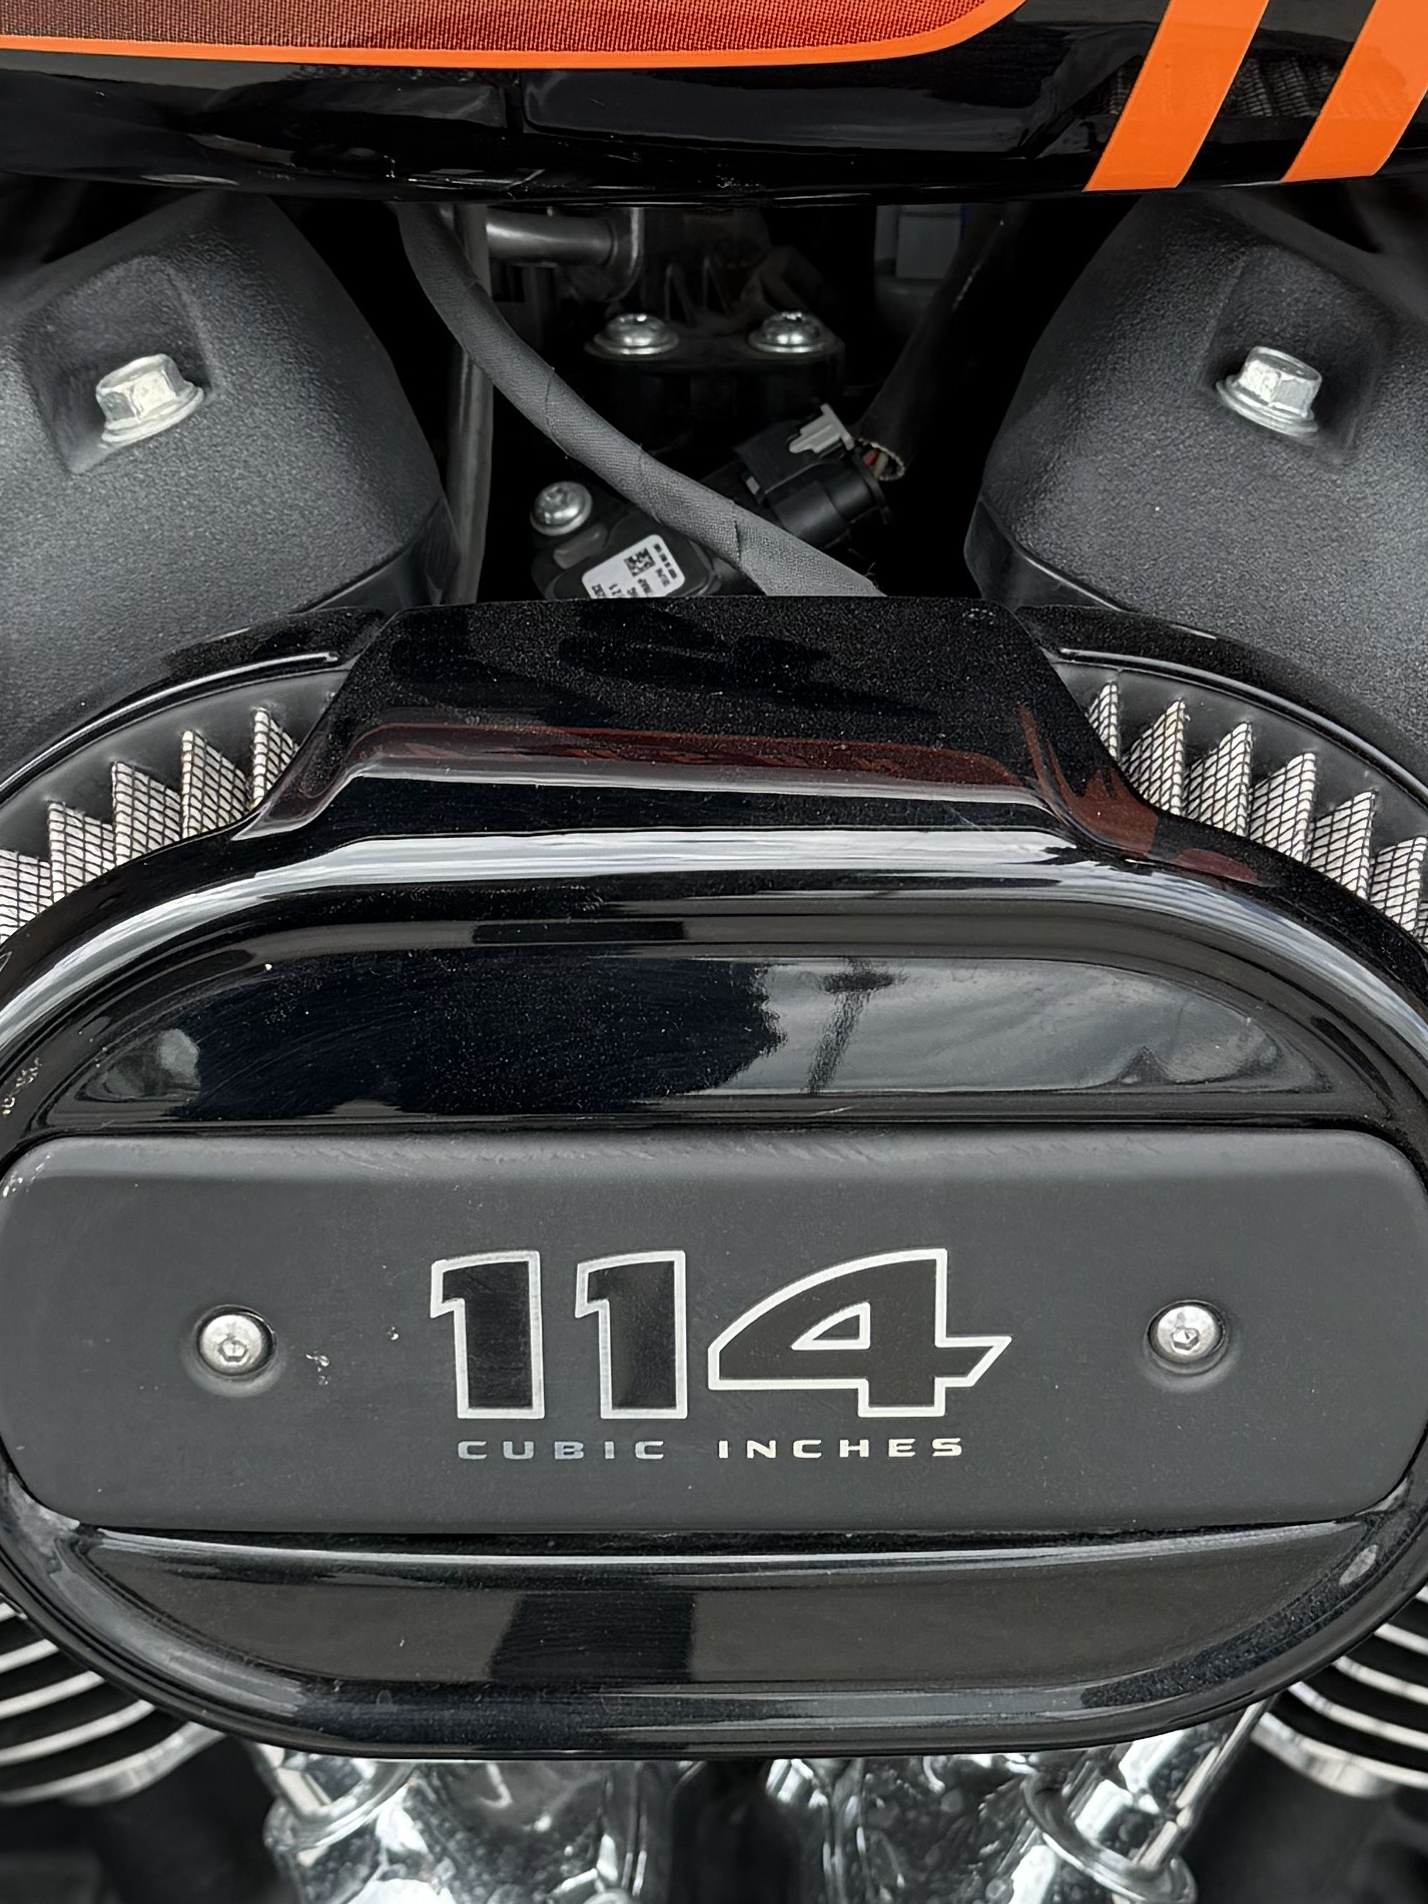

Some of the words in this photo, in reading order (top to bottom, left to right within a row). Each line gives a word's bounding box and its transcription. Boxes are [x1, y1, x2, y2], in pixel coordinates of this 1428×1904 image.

[430, 1248, 1012, 1420] 114
[457, 1439, 666, 1462] CUBIC
[717, 1436, 963, 1460] INCHES
